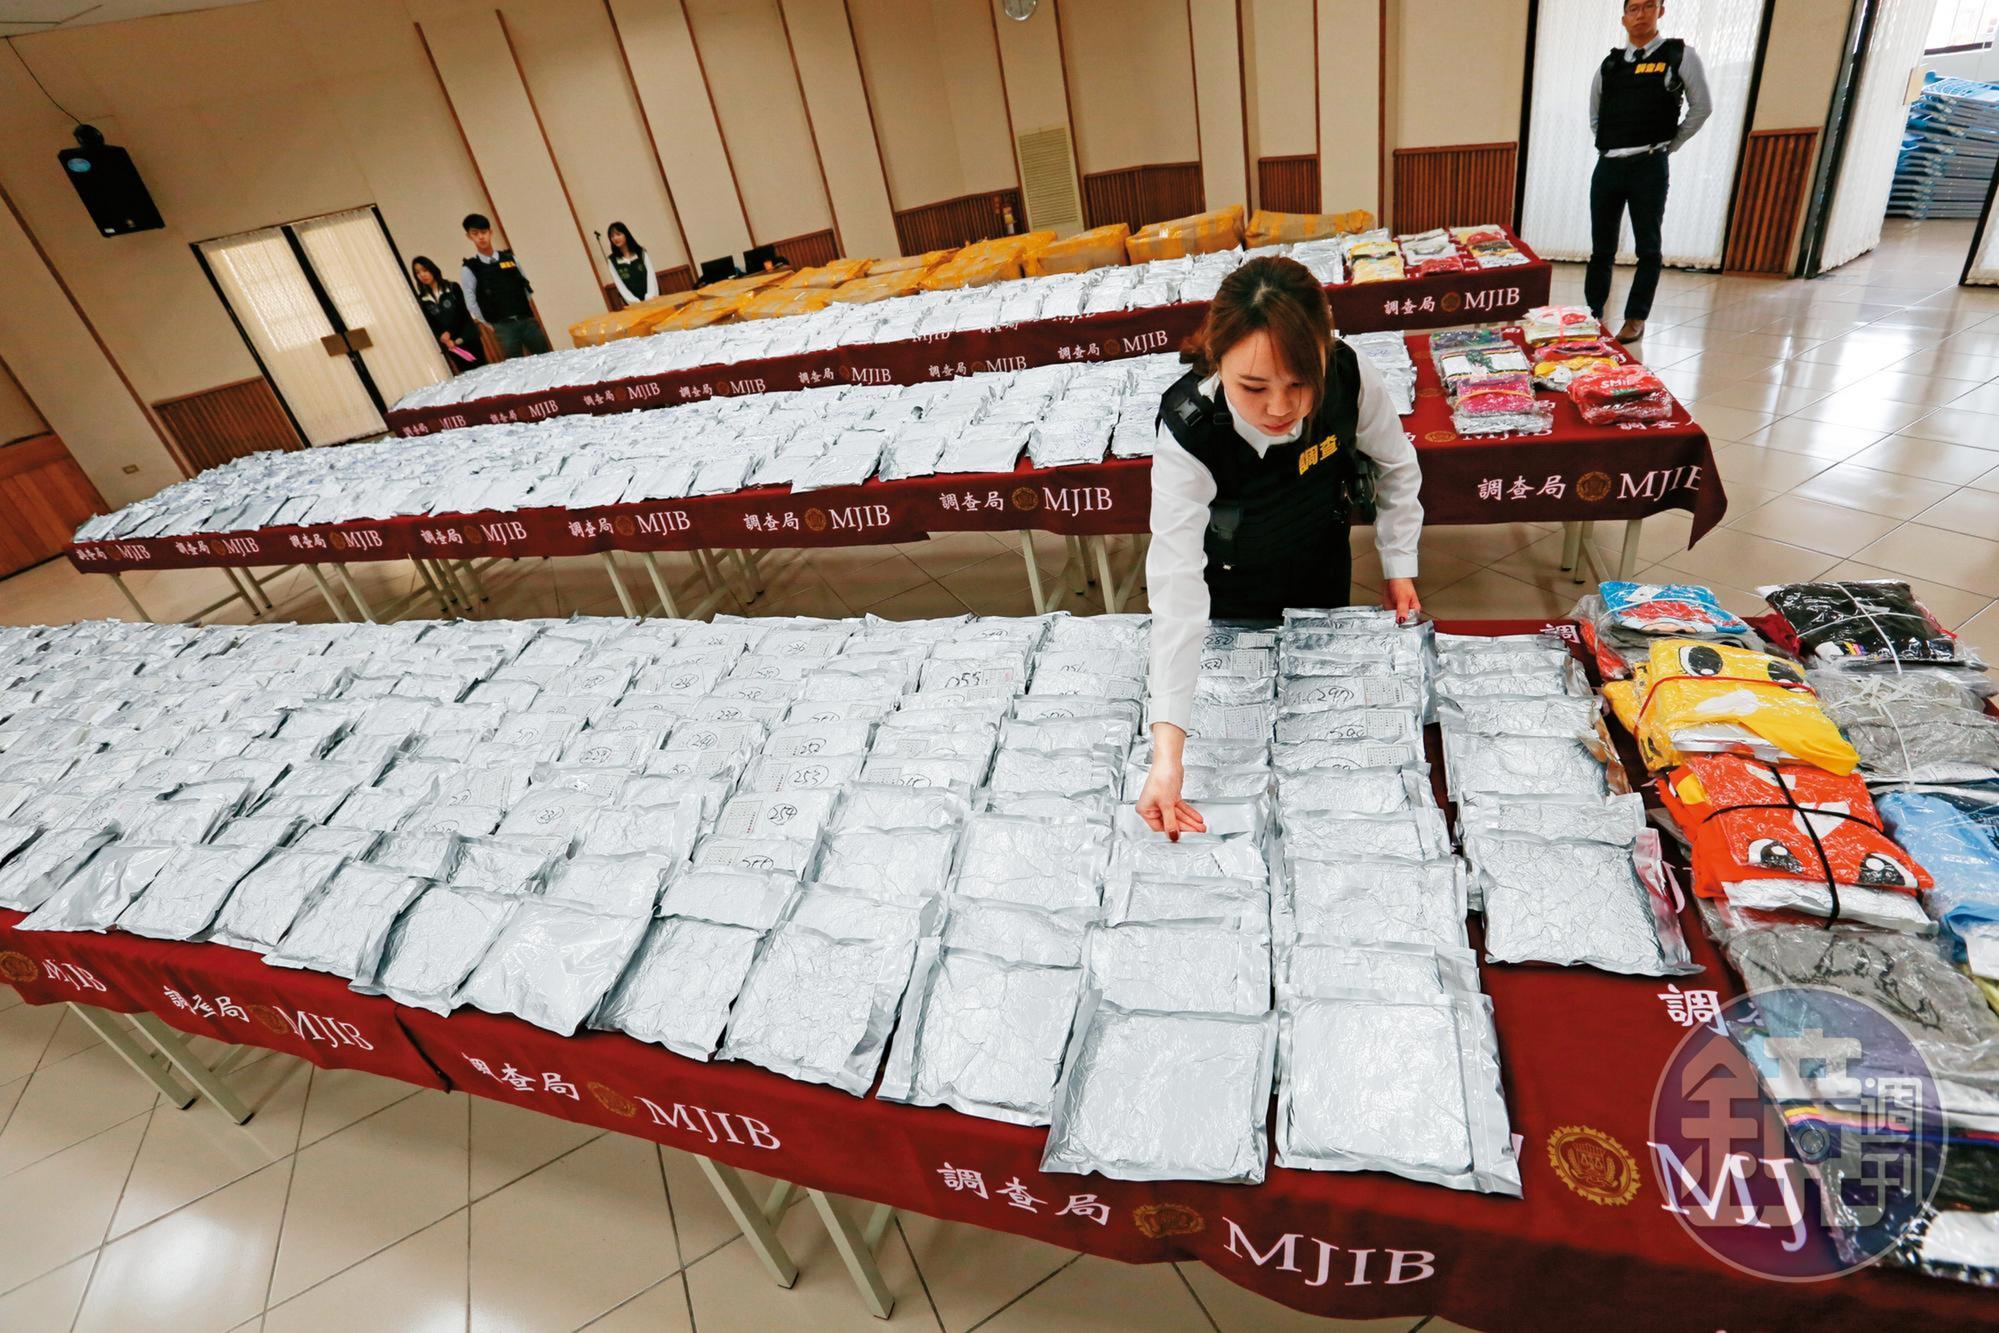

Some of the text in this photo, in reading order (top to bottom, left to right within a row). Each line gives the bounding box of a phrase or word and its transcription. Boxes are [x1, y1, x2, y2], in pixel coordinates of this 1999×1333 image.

[1384, 287, 1520, 315] 調查局 MJIB
[1057, 330, 1170, 361] 調查局 MJIB
[799, 367, 892, 385] 調查局 MJIB
[985, 355, 1028, 373] MJIB
[627, 382, 661, 400] MJIB
[729, 379, 767, 396] MJIB
[528, 400, 560, 419] MJIB
[1477, 474, 1566, 501] 調查局
[939, 486, 1113, 516] 調查局 MJIB
[568, 511, 691, 538] 調查局 MJIB
[743, 505, 891, 532] 調查局 MJIB
[342, 530, 383, 550] MJIB
[421, 521, 527, 545] 調查局 MJIB
[118, 543, 151, 561] MJIB
[224, 537, 260, 557] MJIB
[272, 1005, 374, 1051] MJIB
[634, 1096, 781, 1150] MJIB
[937, 1162, 1436, 1287] 調查局 MJIB
